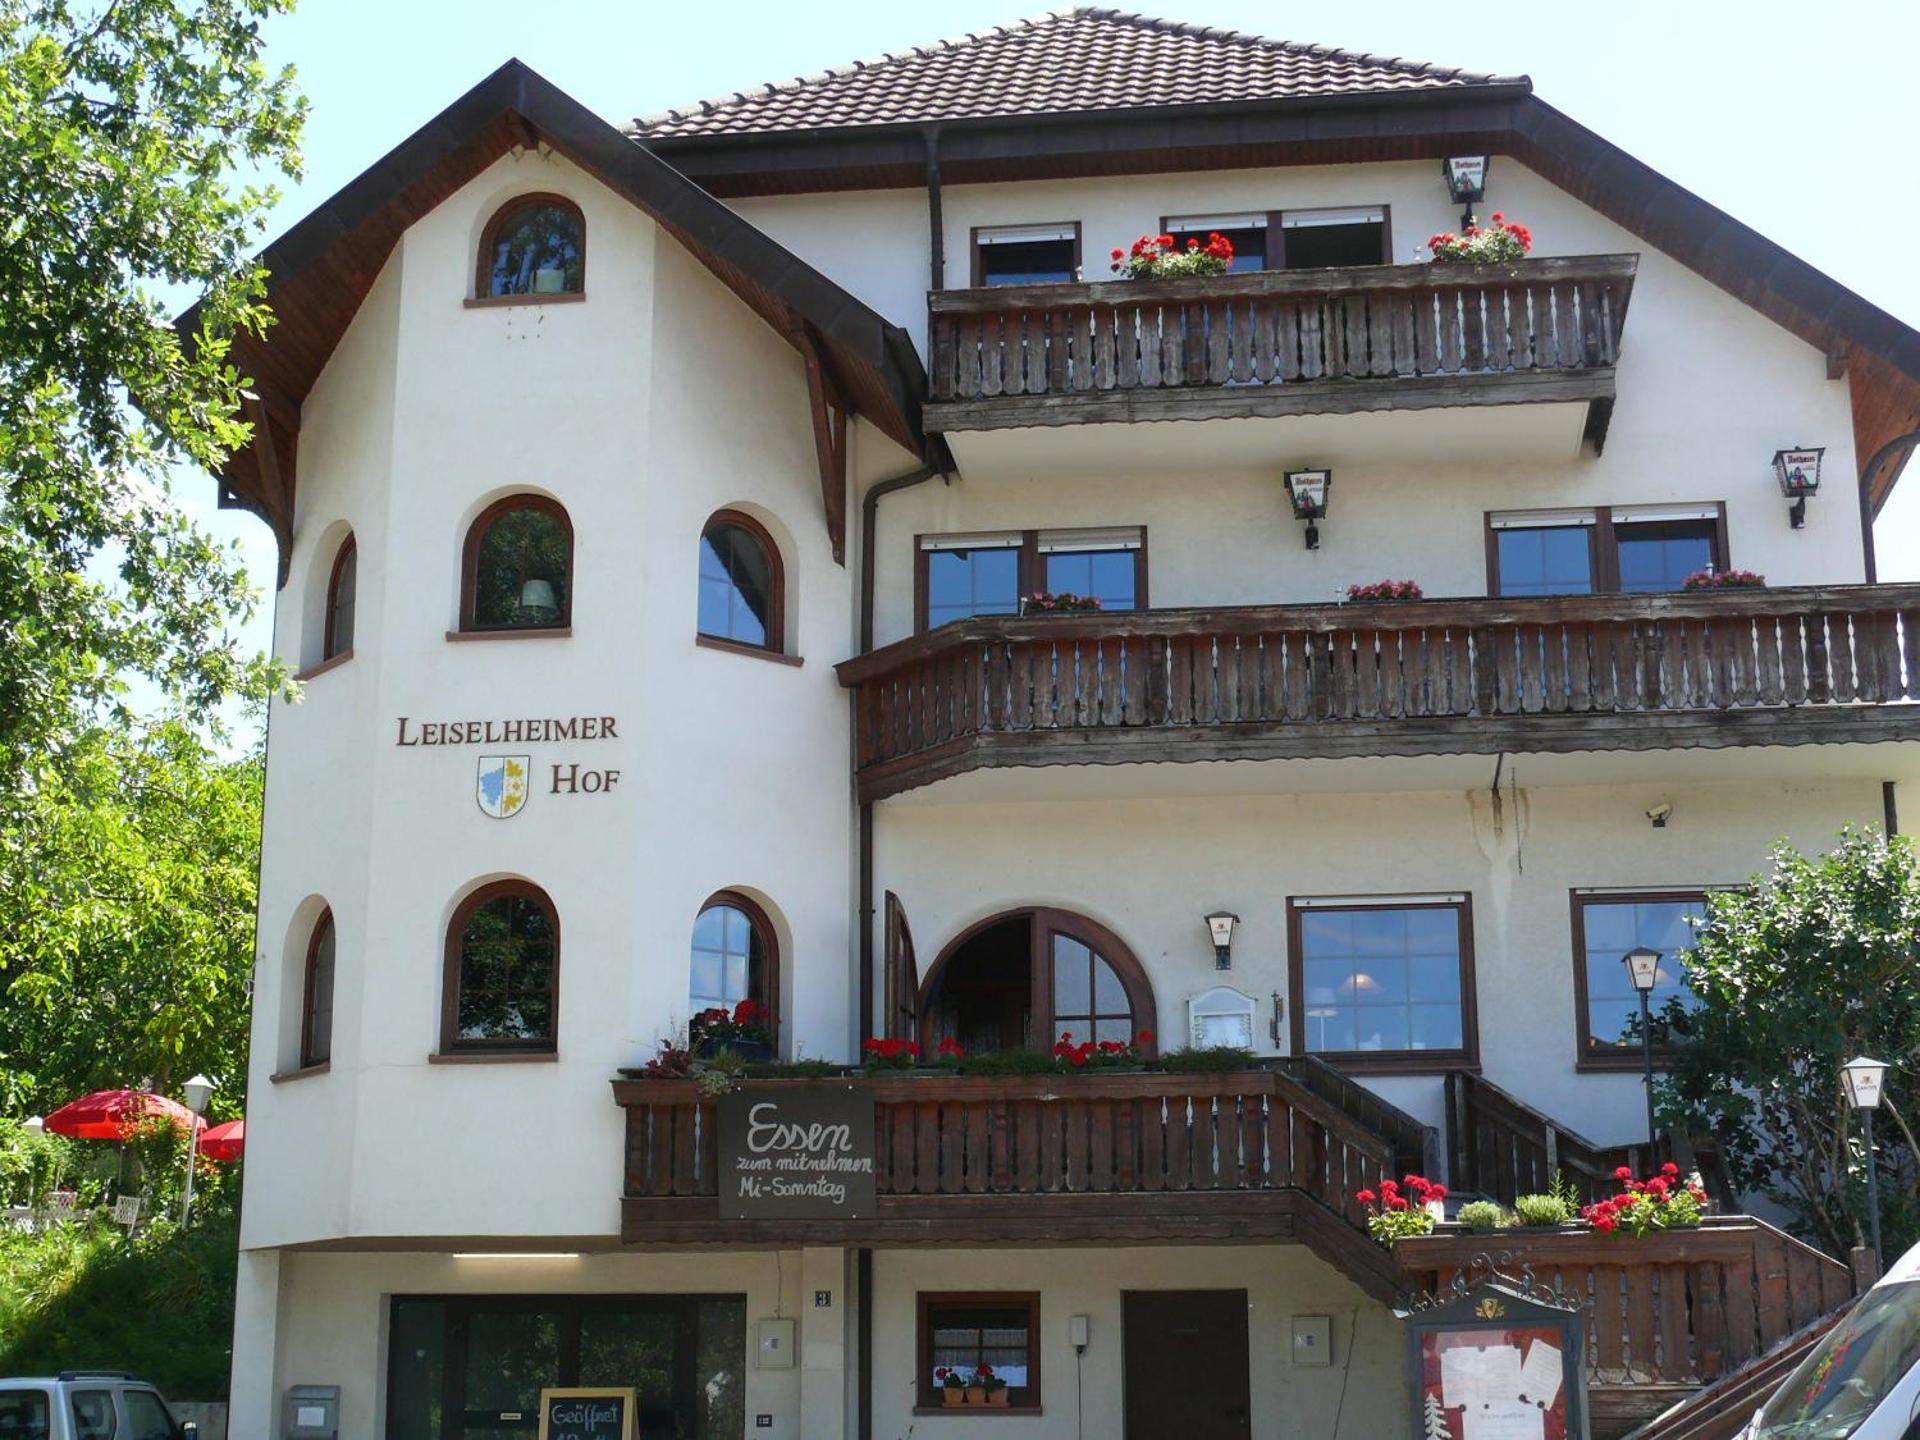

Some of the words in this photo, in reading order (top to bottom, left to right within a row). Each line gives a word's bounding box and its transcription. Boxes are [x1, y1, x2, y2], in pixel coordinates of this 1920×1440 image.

[396, 717, 619, 746] LEISELHEIMER
[549, 764, 620, 793] HOF
[747, 1103, 852, 1153] Essen
[736, 1156, 772, 1171] zum
[776, 1150, 872, 1173] mitnehmen
[738, 1175, 845, 1204] Mi-Sonntag
[551, 1403, 618, 1431] Geöffnet
